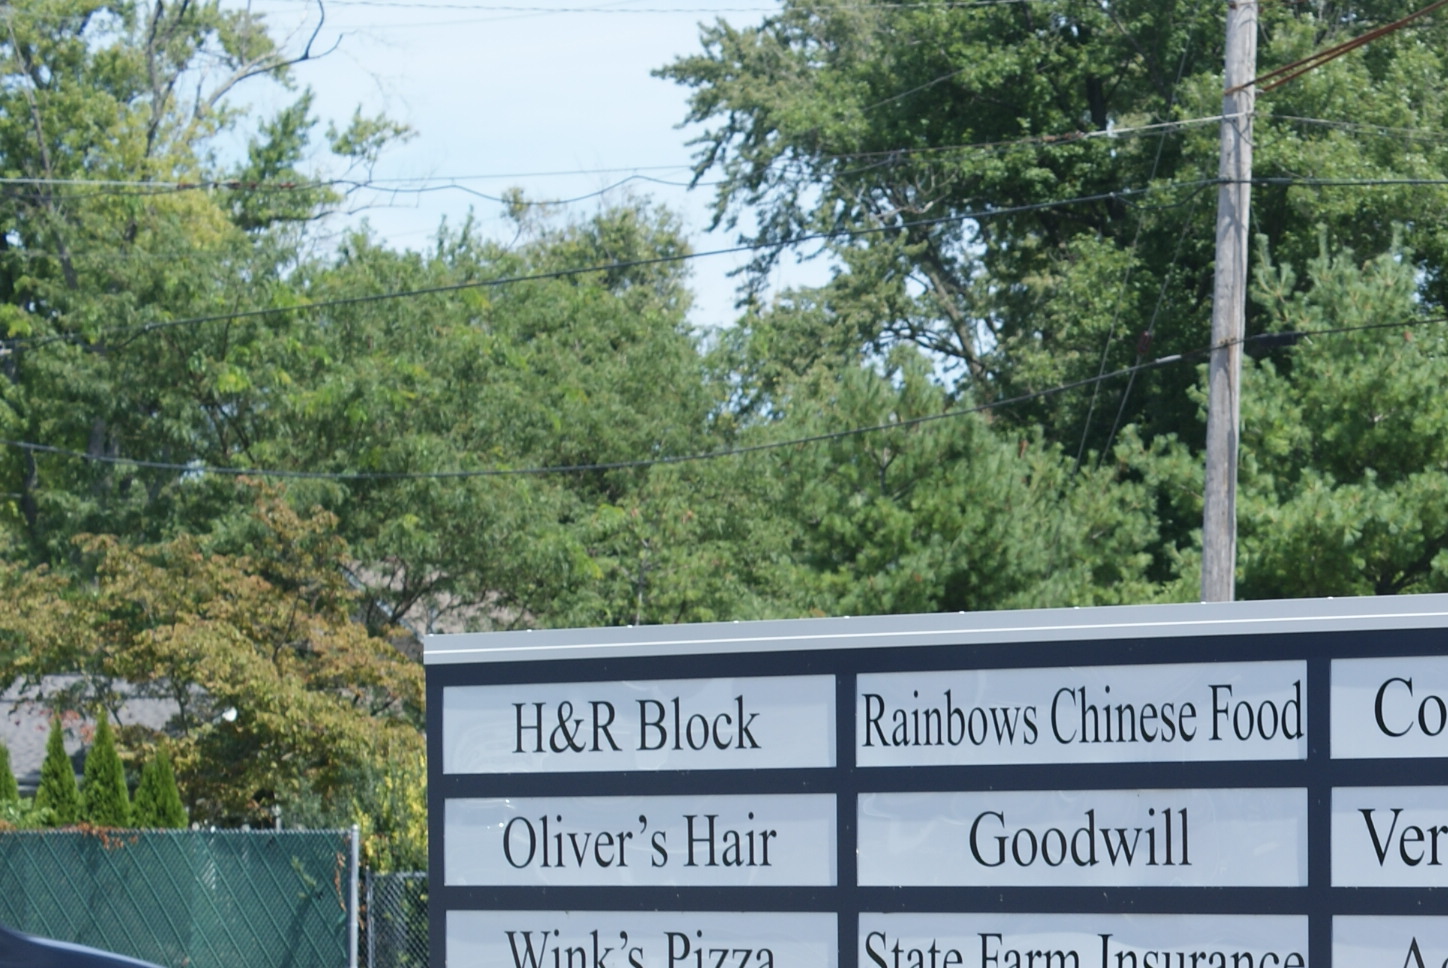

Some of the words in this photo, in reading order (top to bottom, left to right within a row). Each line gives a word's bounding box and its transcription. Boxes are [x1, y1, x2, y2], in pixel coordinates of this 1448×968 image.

[512, 700, 622, 754] H&R
[635, 694, 761, 751] Block
[862, 688, 1038, 747] Rainbows
[1050, 685, 1197, 745] Chinese
[1208, 679, 1304, 741] Food
[503, 814, 668, 869] Oliver's
[682, 811, 777, 867] Hair
[969, 807, 1192, 868] Goodwill
